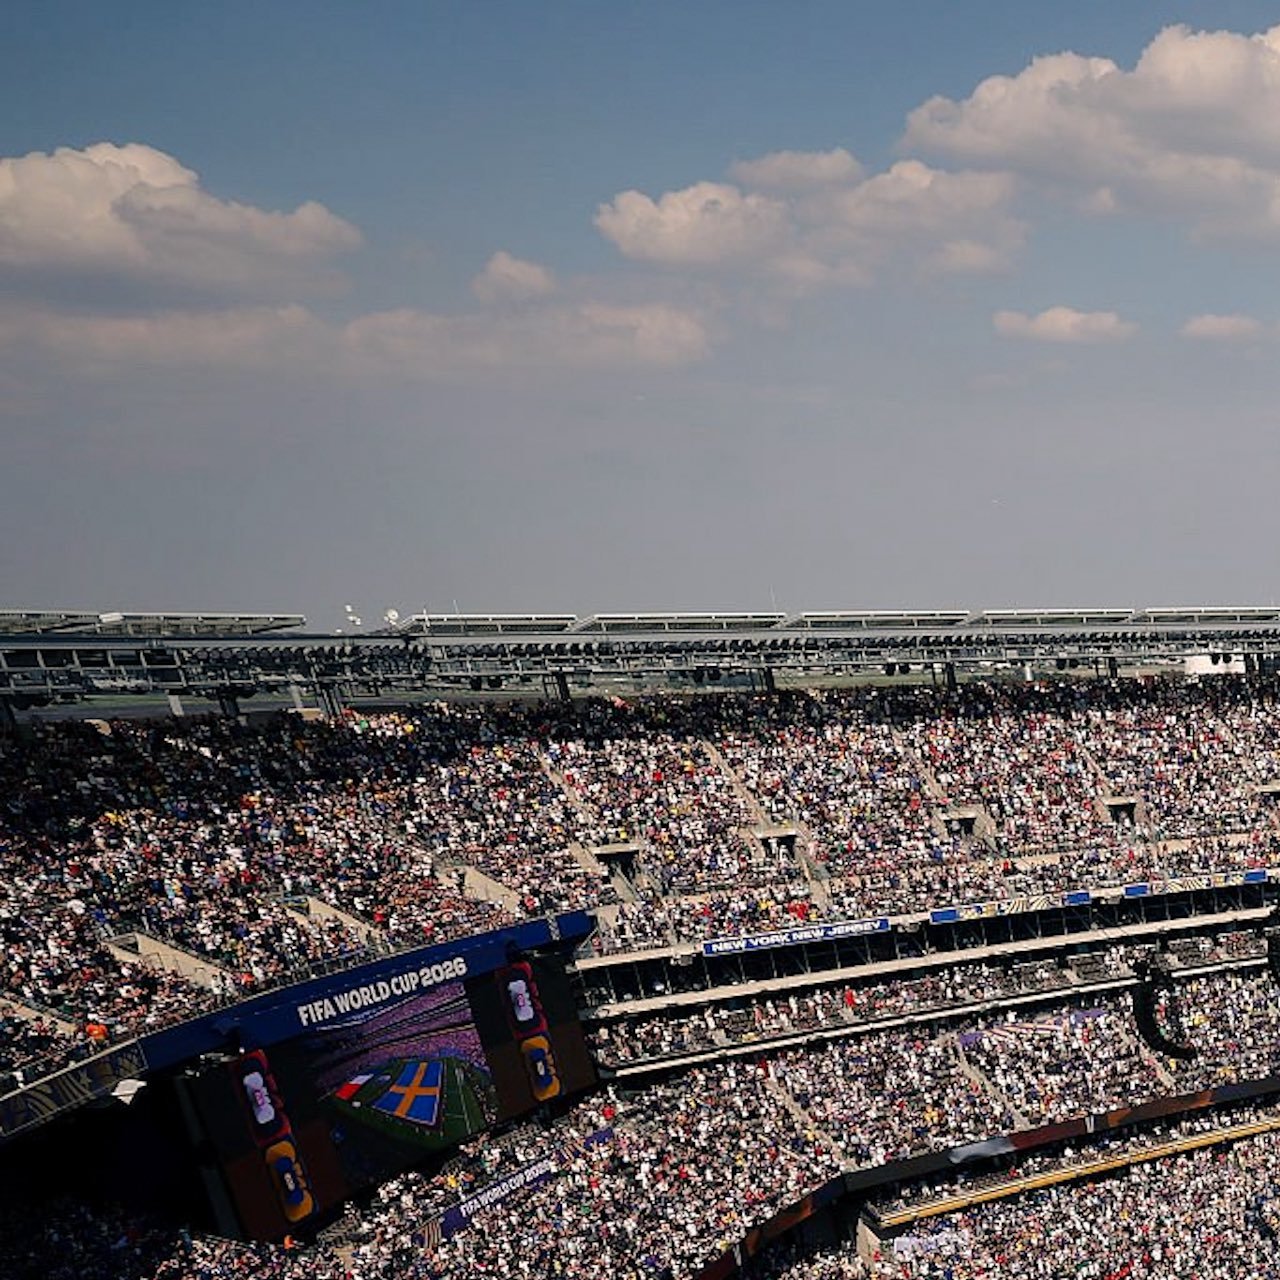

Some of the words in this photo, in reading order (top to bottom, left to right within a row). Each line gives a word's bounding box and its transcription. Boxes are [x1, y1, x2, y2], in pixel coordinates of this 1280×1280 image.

[711, 939, 747, 952] NEW
[748, 932, 791, 947] YORK
[791, 928, 826, 942] NEW
[827, 920, 881, 936] JERSEY
[297, 998, 337, 1027] FIFA
[333, 981, 391, 1014] WORLD
[390, 971, 420, 996] CUP
[418, 956, 468, 988] 2026
[459, 1199, 482, 1218] FIFA
[478, 1183, 510, 1206] WORLD
[507, 1174, 525, 1195] CUP
